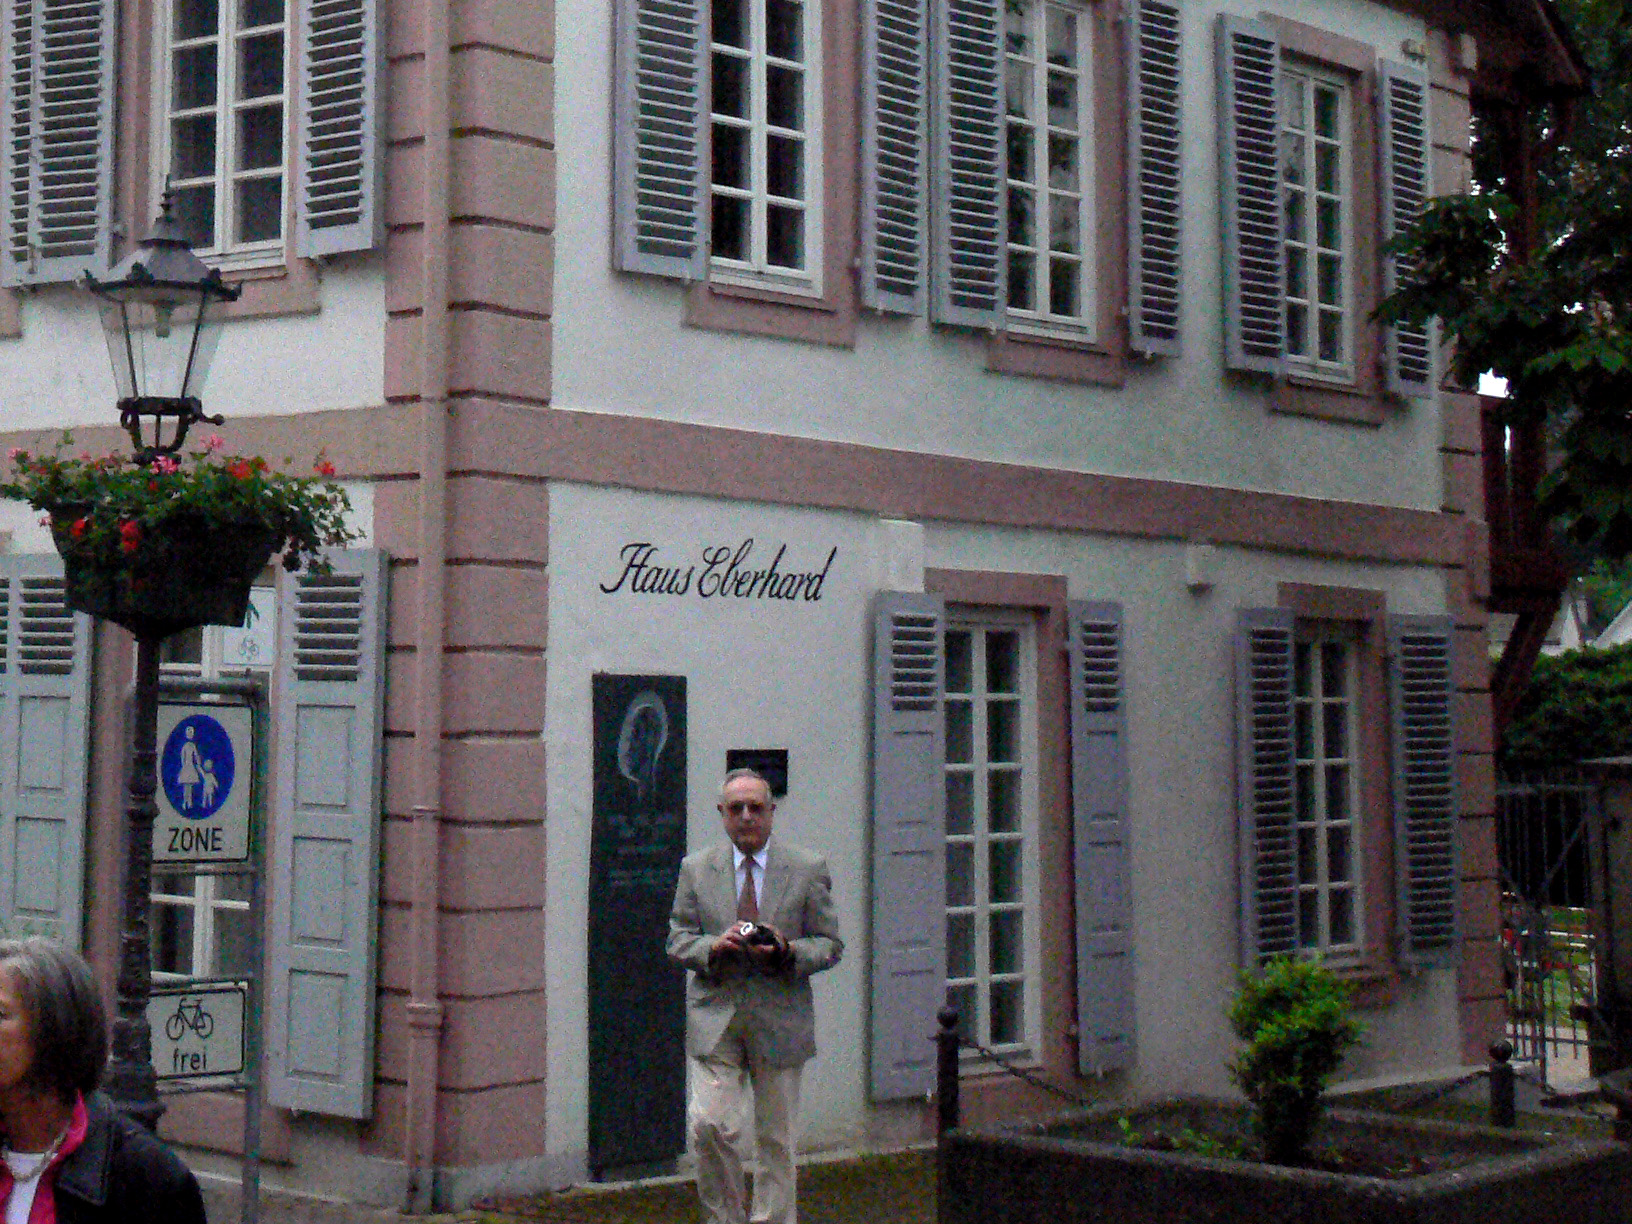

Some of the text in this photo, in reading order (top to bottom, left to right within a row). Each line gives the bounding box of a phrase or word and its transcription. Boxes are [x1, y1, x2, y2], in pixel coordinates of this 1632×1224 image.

[599, 537, 838, 602] Haus Eberhard
[167, 826, 224, 853] ZONE
[172, 1045, 208, 1072] frei
